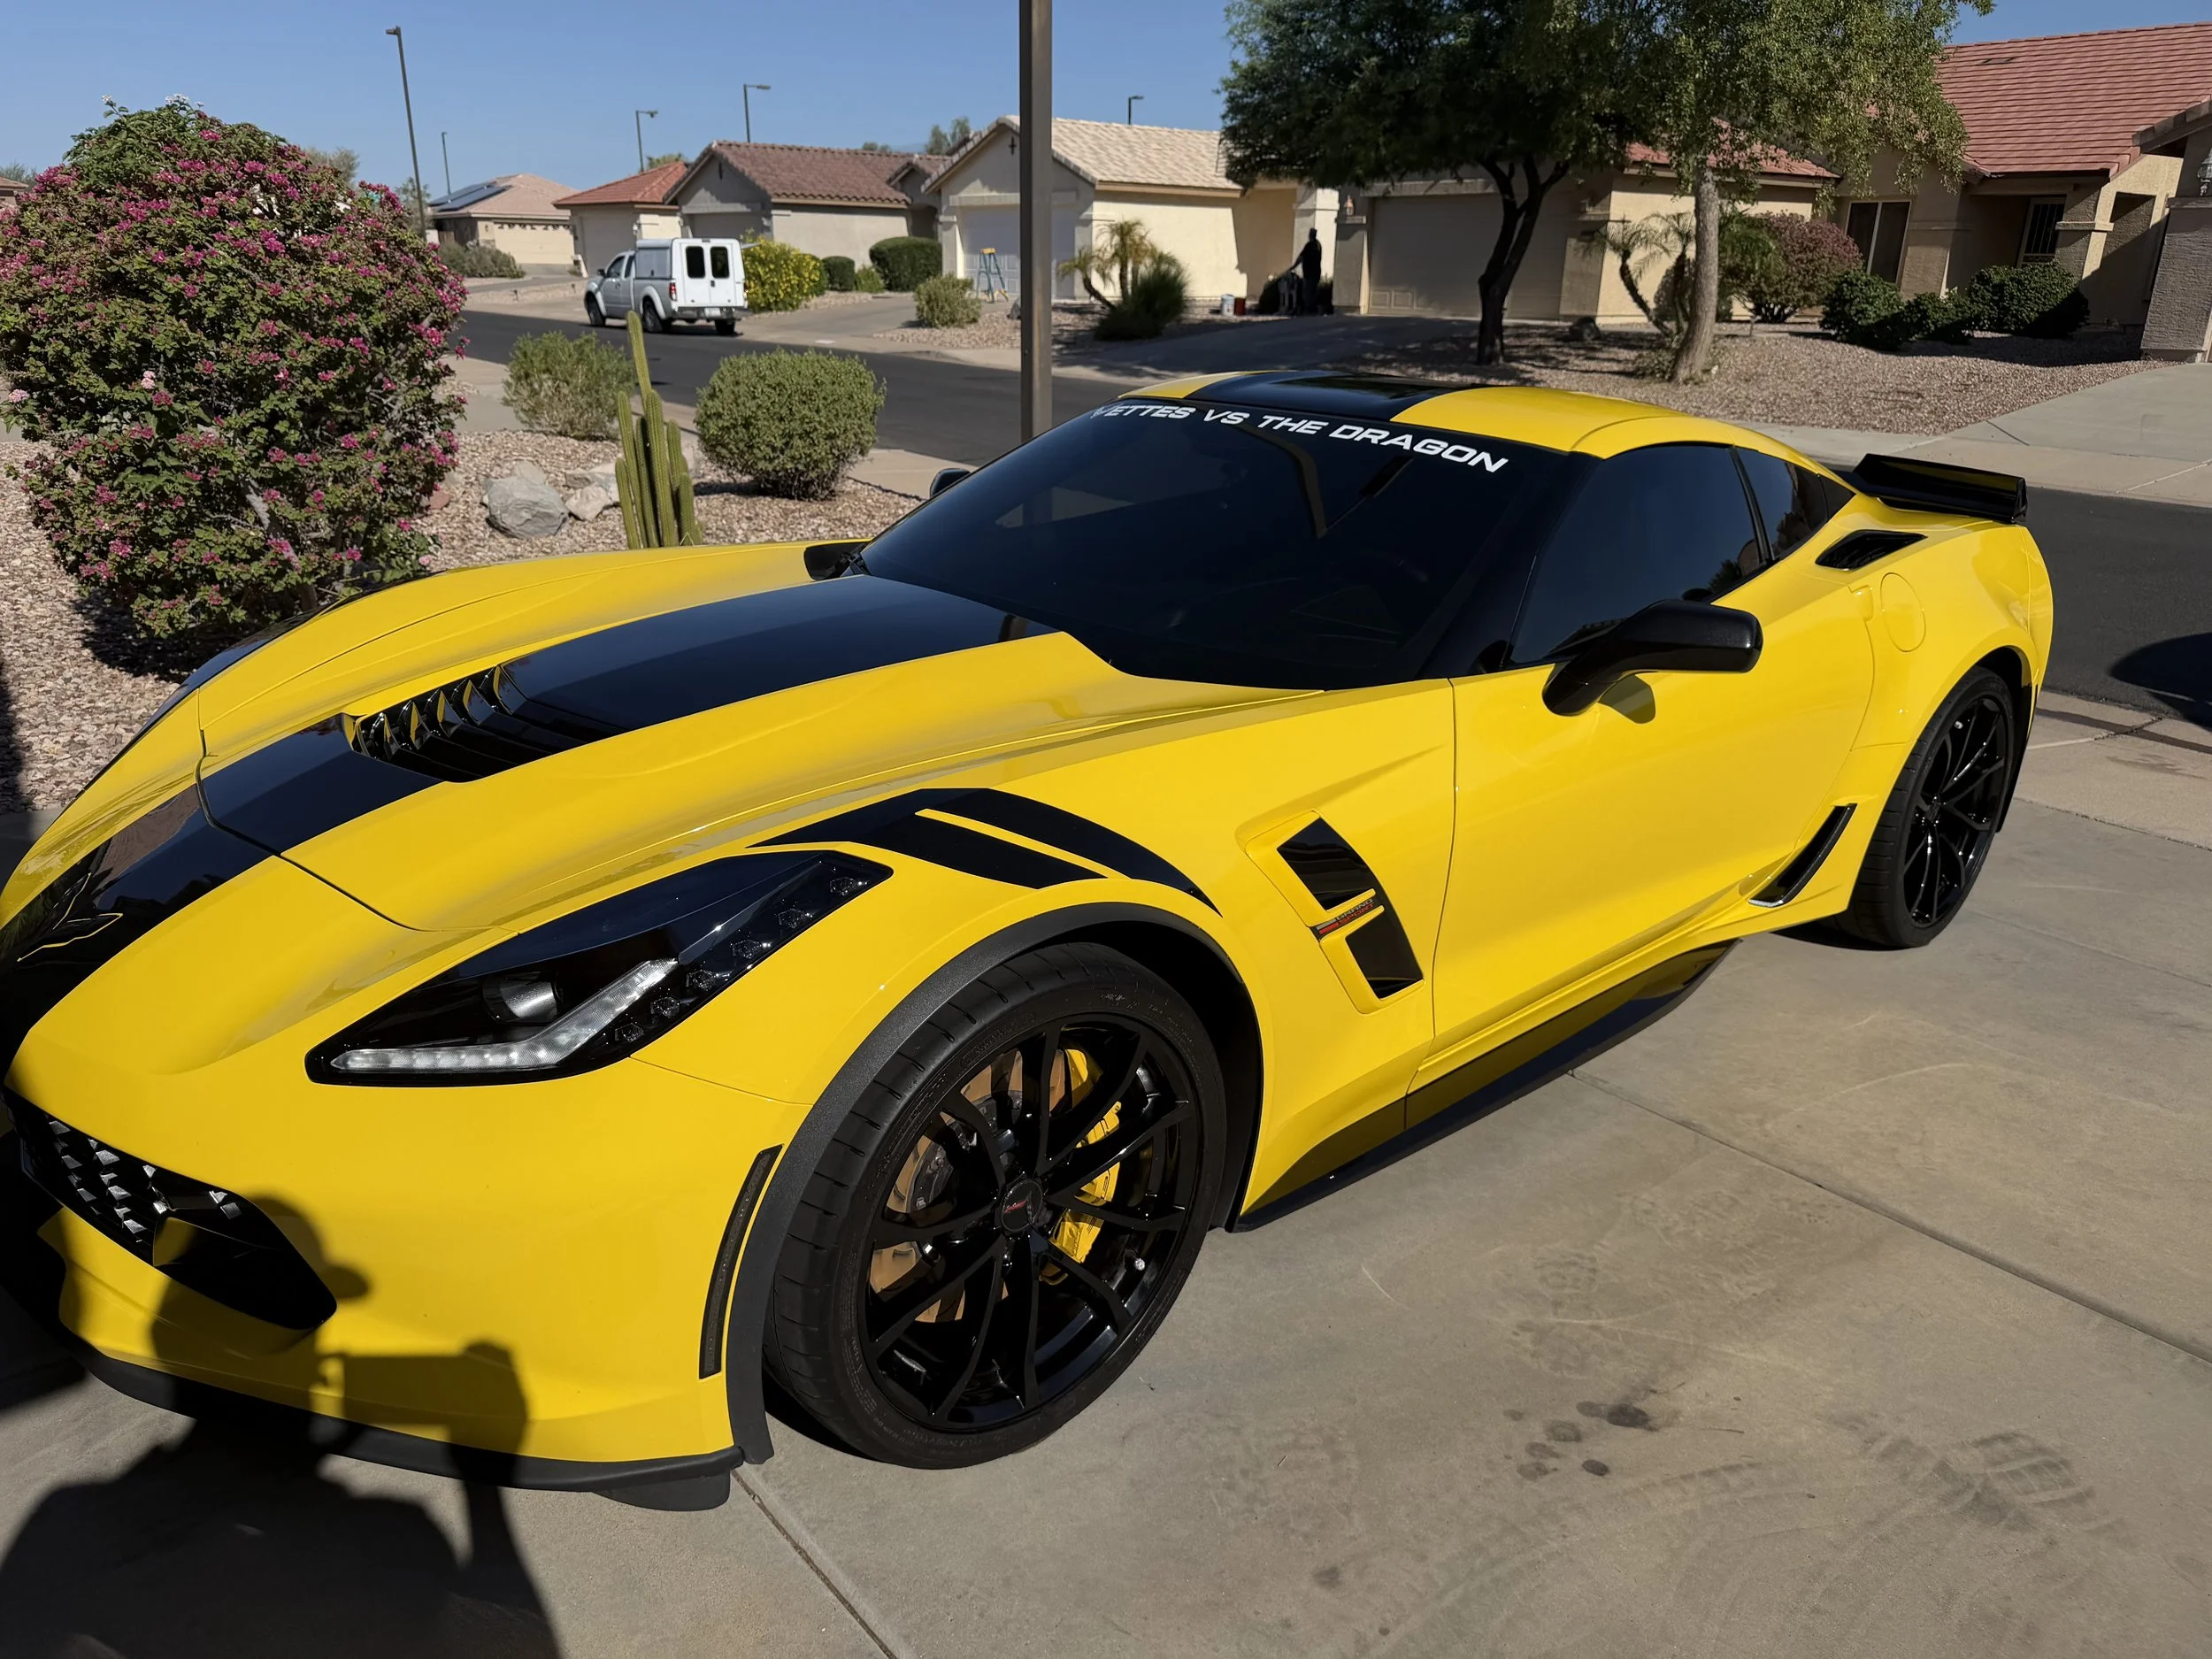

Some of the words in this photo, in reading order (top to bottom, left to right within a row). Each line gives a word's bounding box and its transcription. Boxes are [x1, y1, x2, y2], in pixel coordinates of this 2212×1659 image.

[1203, 409, 1250, 425] VS
[1257, 415, 1329, 434] THE
[1328, 424, 1509, 472] DRAGON
